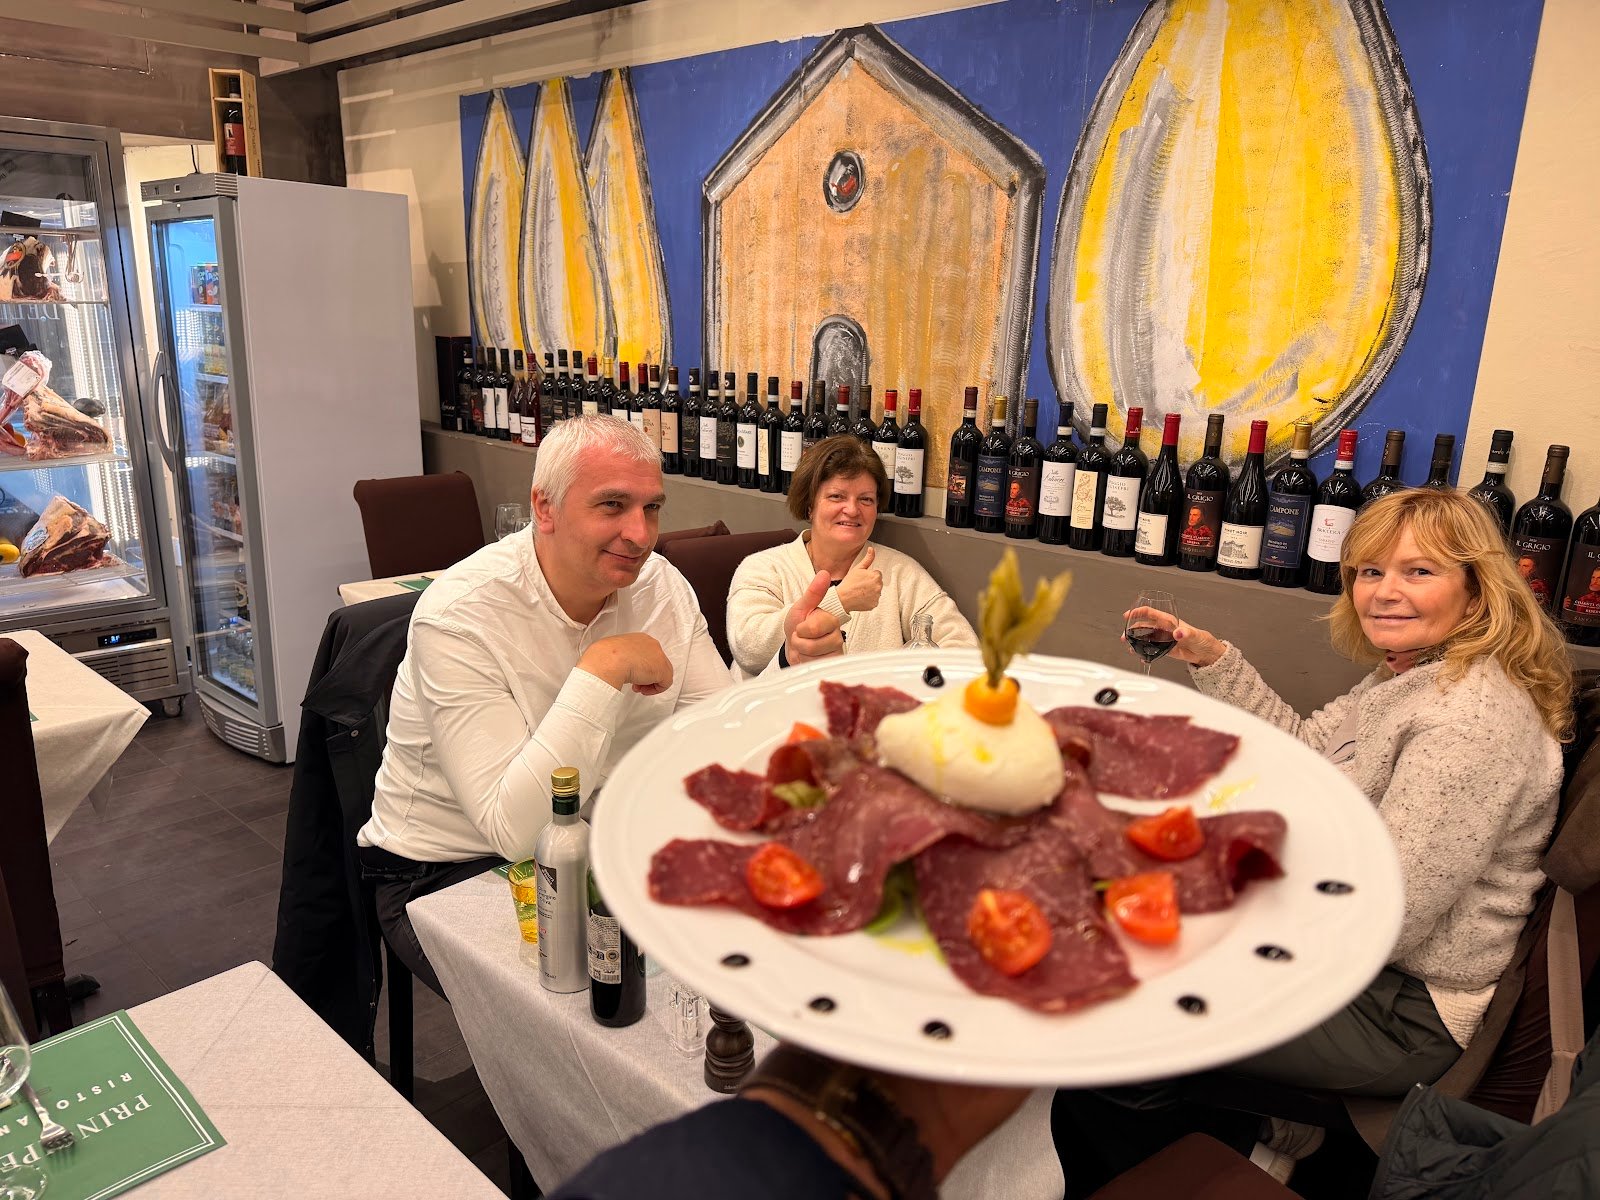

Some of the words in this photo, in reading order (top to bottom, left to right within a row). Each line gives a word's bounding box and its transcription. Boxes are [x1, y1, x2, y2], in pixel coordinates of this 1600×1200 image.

[1269, 504, 1300, 515] CAMPONE
[1515, 539, 1521, 547] IL
[1522, 541, 1551, 551] GRIGIO
[1587, 551, 1595, 559] IL
